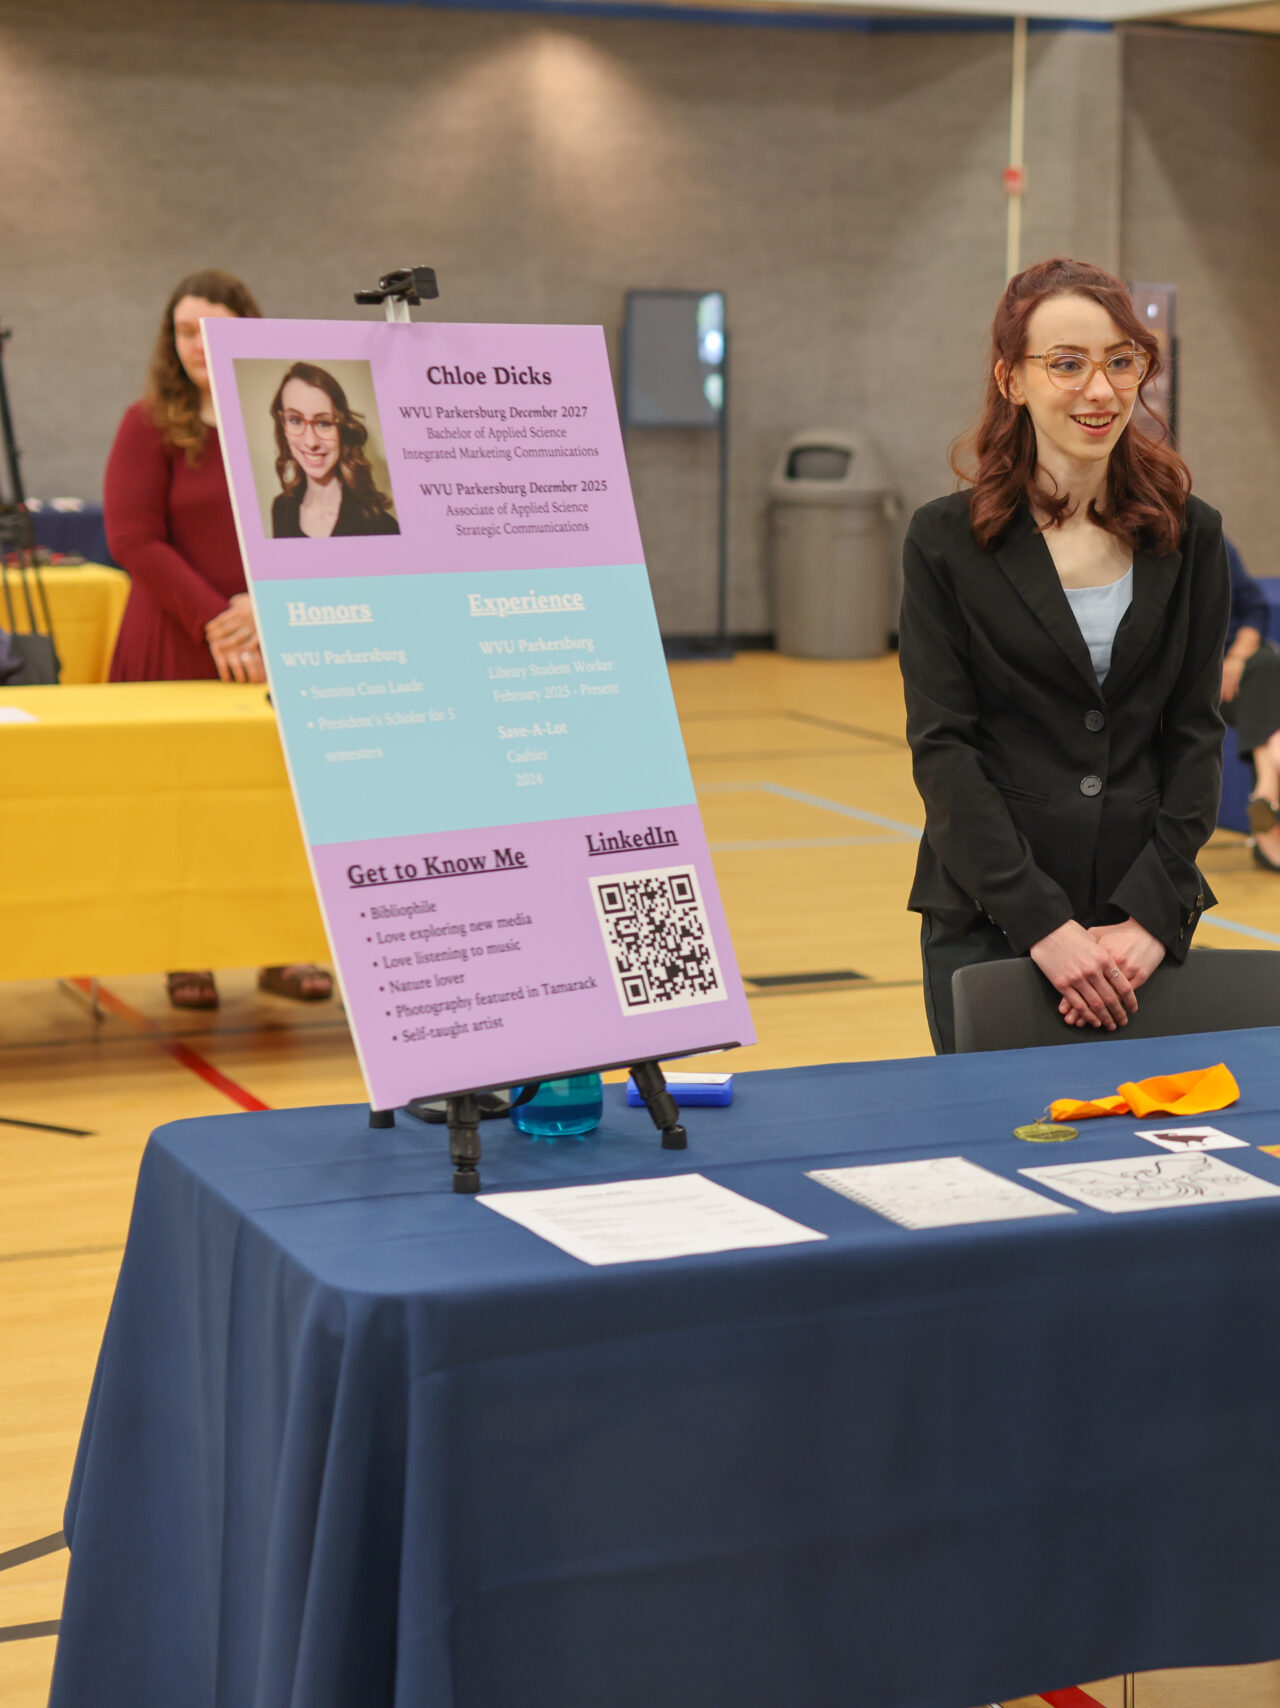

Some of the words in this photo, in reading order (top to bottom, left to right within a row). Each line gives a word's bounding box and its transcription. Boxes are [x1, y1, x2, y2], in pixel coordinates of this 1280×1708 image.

[426, 365, 487, 385] Chloe
[493, 365, 552, 385] Dicks
[399, 406, 433, 419] WVU
[436, 406, 507, 421] Parkersburg
[509, 406, 558, 419] December
[561, 406, 588, 419] 2027
[427, 426, 472, 440] Bachelor
[474, 426, 486, 439] of
[488, 426, 527, 442] Applied
[529, 426, 567, 438] Science
[402, 447, 456, 461] Integrated
[459, 446, 512, 461] Marketing
[514, 446, 599, 459] Communications
[419, 483, 453, 496] WVU
[456, 482, 527, 497] Parkersburg
[529, 481, 578, 493] December
[581, 481, 608, 493] 2025
[446, 503, 494, 516] Associate
[497, 503, 508, 516] of
[510, 502, 550, 518] Applied
[552, 501, 589, 514] Science
[456, 524, 501, 538] Strategic
[503, 520, 589, 535] Communications
[467, 589, 586, 617] Experience
[286, 601, 373, 626] Honors
[478, 640, 515, 655] WVU
[518, 637, 595, 652] Parkersburg
[281, 652, 321, 667] WVU
[324, 648, 407, 665] Parkersburg
[489, 665, 526, 679] Library
[529, 662, 570, 676] Student
[573, 659, 614, 672] Worker
[493, 689, 541, 703] February
[544, 686, 570, 699] 2025
[580, 683, 620, 697] Present
[318, 714, 381, 731] President's
[384, 711, 426, 726] Scholar
[498, 721, 568, 740] Save-A-Lot
[507, 749, 548, 763] Cashier
[585, 826, 679, 856] LinkedIn
[347, 863, 389, 888] Get
[395, 860, 418, 880] to
[423, 854, 487, 876] Know
[493, 847, 528, 869] Me
[371, 900, 437, 920] Bibliophile
[377, 930, 406, 944] Love
[409, 924, 467, 942] exploring
[469, 919, 494, 933] new
[496, 913, 533, 929] media
[383, 955, 412, 969] Love
[415, 948, 469, 966] listening
[471, 946, 483, 958] to
[486, 939, 520, 954] music
[389, 978, 432, 994] Nature
[434, 973, 465, 987] lover
[395, 996, 472, 1019] Photography
[474, 986, 525, 1006] featured
[527, 985, 540, 998] in
[542, 976, 597, 995] Tamarack
[402, 1021, 469, 1043] Self-taught
[472, 1017, 504, 1034] artist
